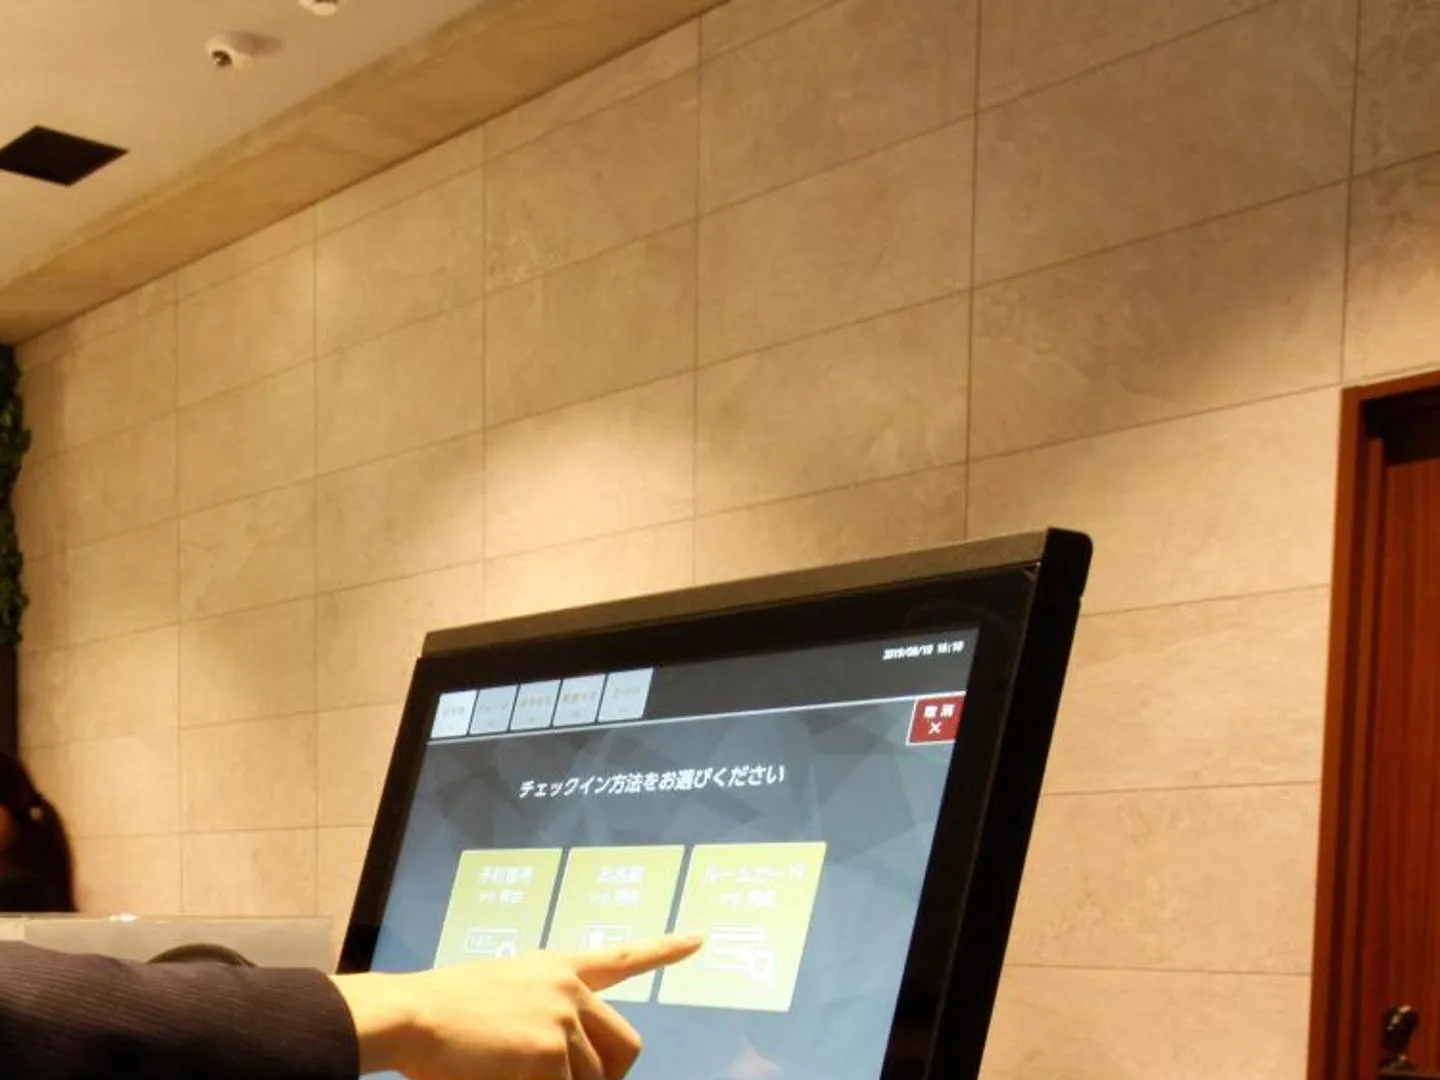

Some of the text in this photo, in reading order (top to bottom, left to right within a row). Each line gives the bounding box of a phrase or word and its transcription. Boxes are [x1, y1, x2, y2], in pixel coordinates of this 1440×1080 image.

[519, 765, 785, 798] チェックイン方法をお選びください
